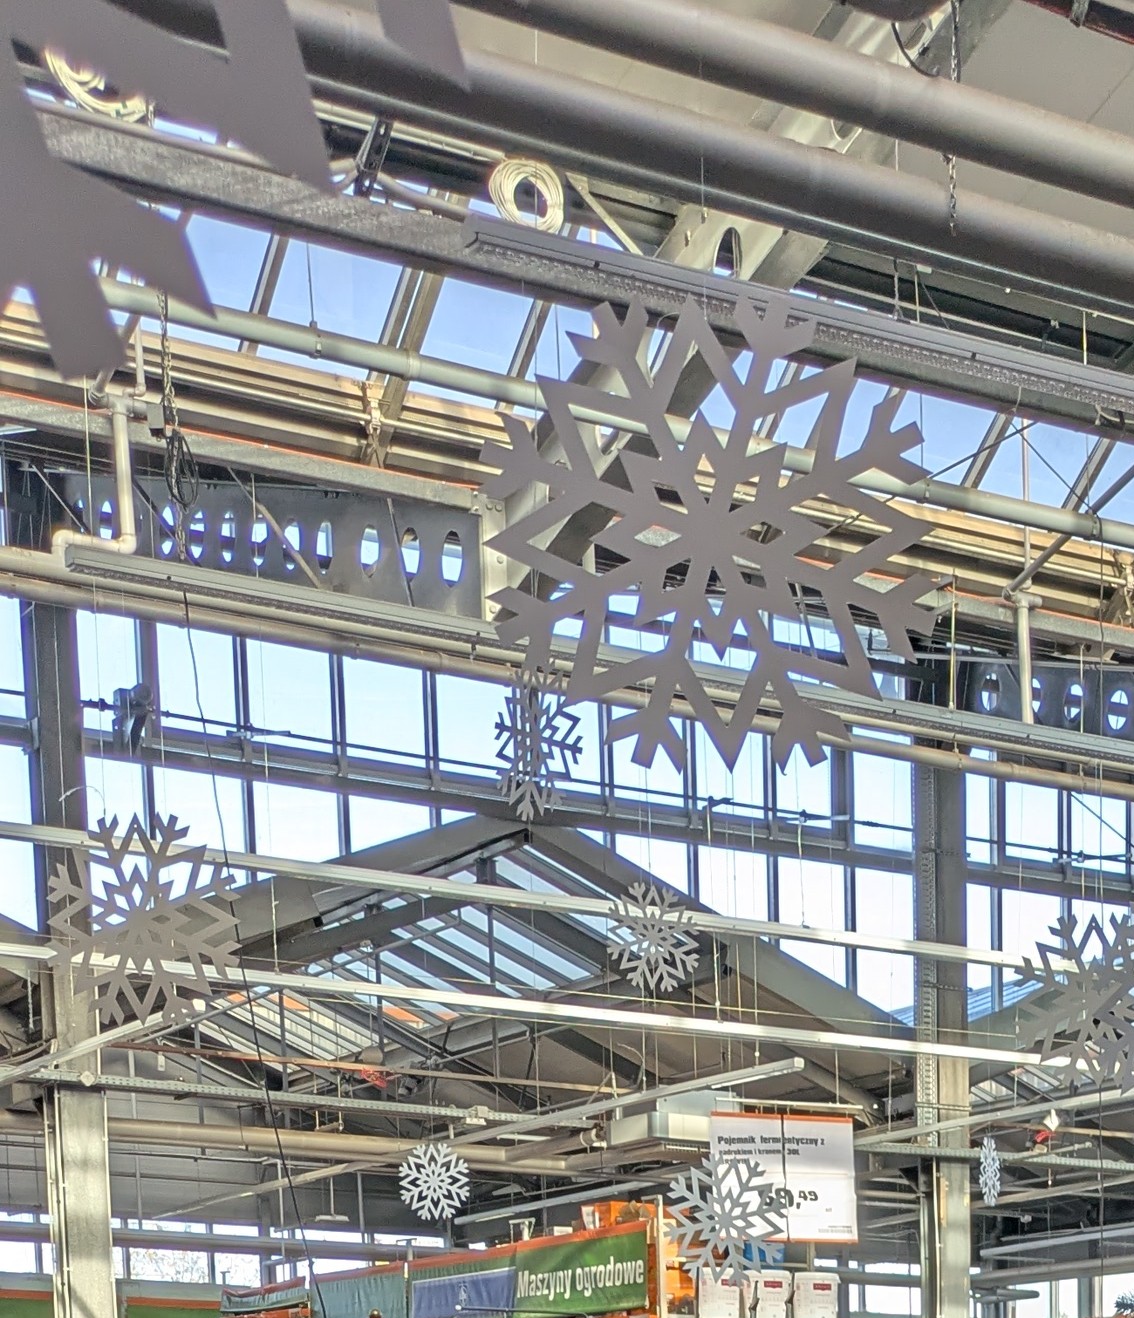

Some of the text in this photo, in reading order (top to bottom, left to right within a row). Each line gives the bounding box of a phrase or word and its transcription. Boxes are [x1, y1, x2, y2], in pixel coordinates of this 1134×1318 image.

[717, 1136, 756, 1146] Pojemnik
[517, 1256, 644, 1300] Maszyny ogrodowe
